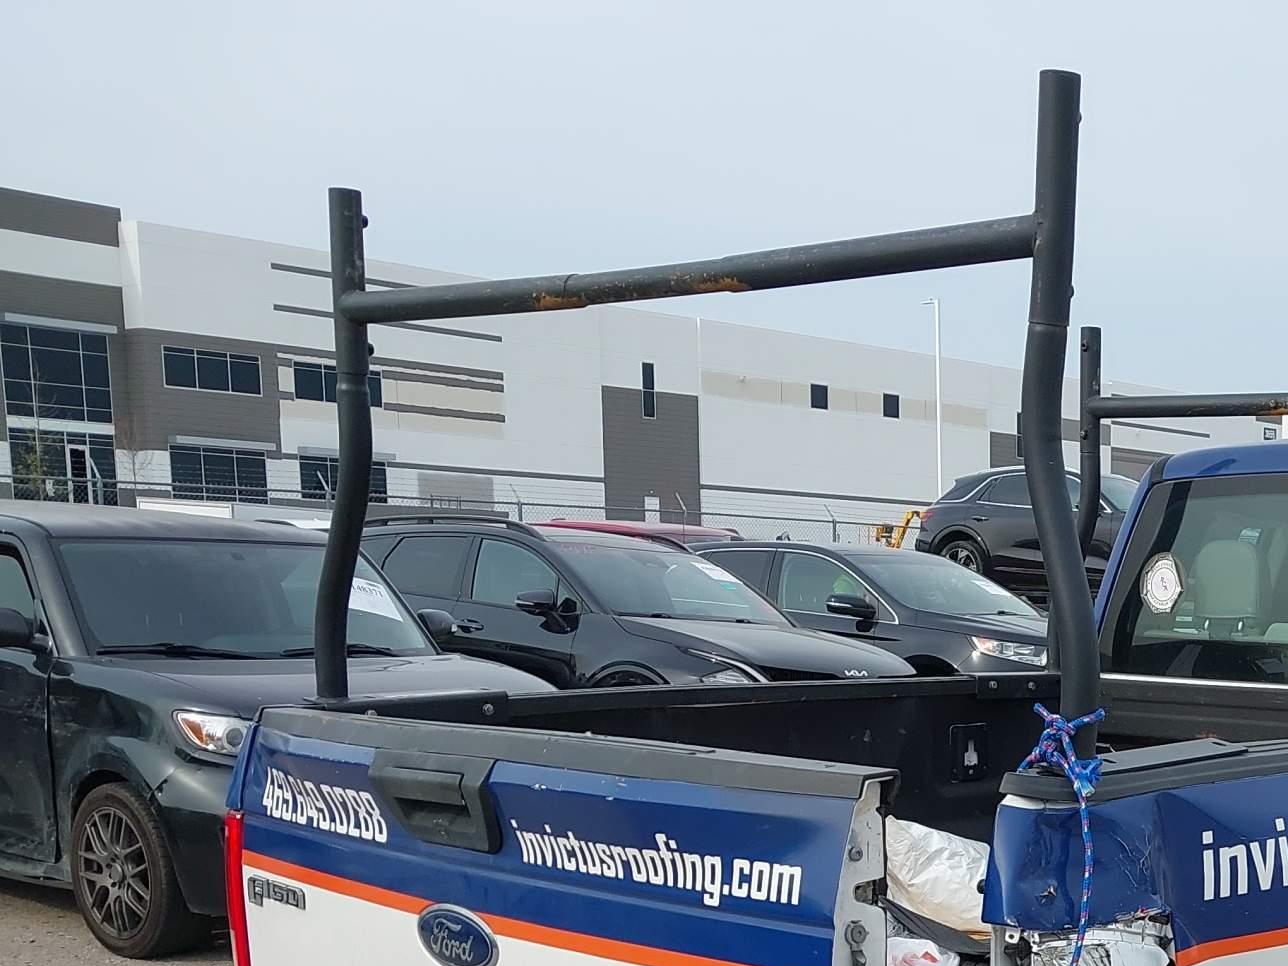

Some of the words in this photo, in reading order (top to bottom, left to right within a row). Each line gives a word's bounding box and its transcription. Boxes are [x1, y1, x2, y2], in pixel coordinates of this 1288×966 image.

[262, 766, 387, 843] 469.649.0288
[510, 819, 802, 907] invictusroofing.com
[430, 917, 474, 962] Ford
